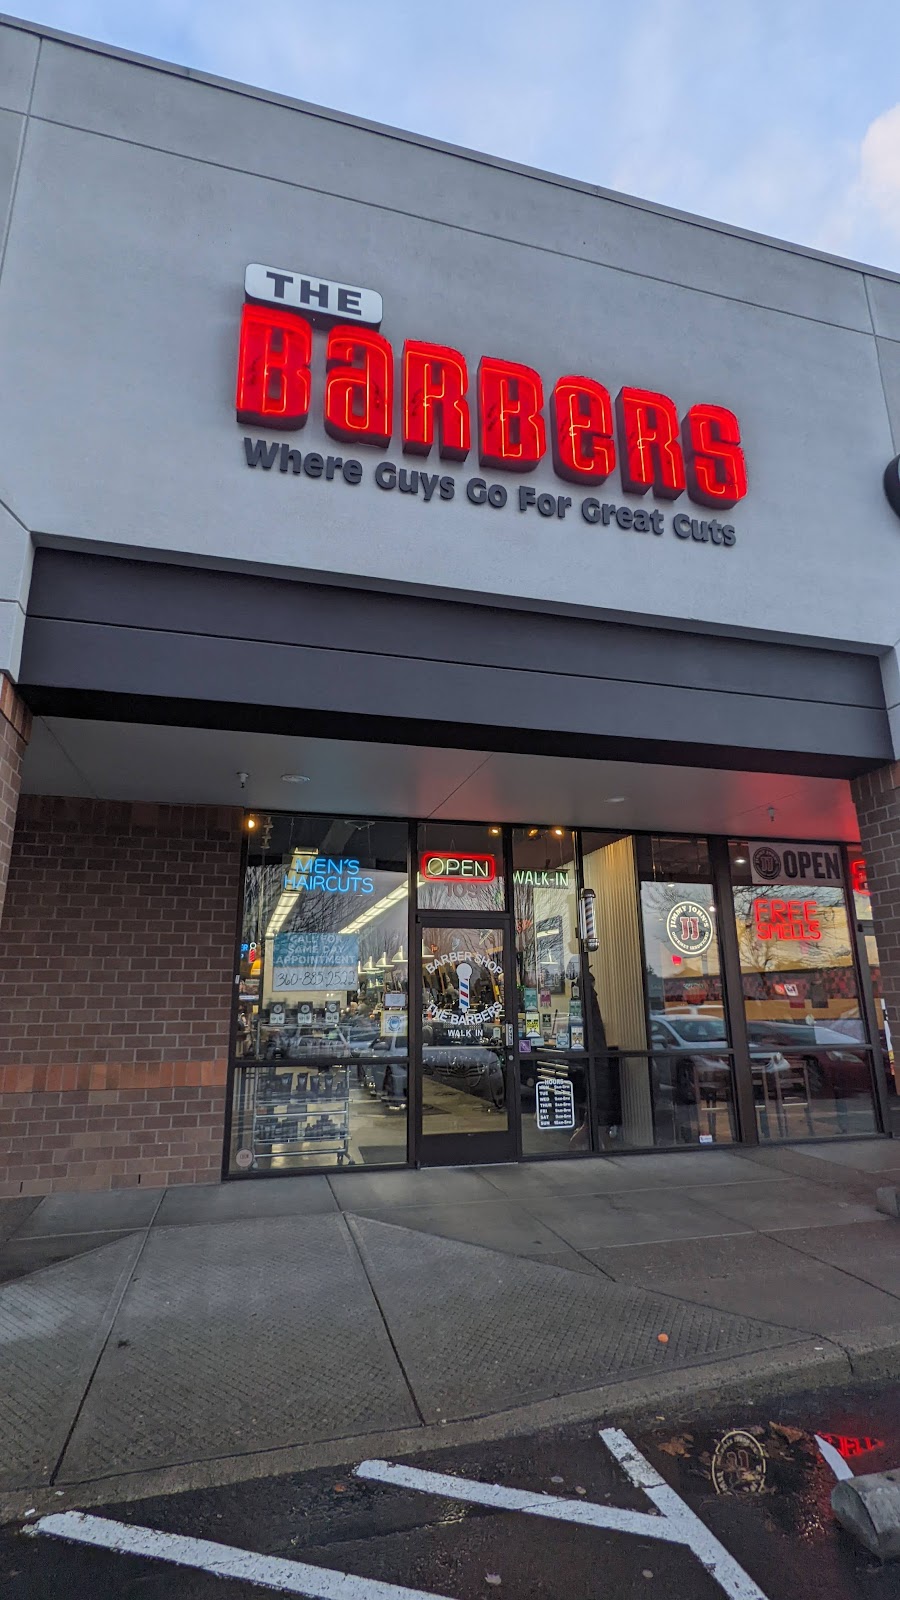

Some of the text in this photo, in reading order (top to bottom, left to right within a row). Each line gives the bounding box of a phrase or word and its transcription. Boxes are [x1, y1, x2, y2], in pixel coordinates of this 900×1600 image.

[266, 270, 363, 317] THE
[243, 436, 737, 546] Where Guys Go For Great Cuts
[296, 858, 360, 875] MEN'S
[428, 857, 489, 877] OPEN
[783, 850, 841, 879] OPEN
[284, 875, 374, 893] HAIRCUTS
[513, 869, 569, 887] WALK-IN
[670, 905, 709, 928] JIMMY JOHN'S
[754, 898, 819, 925] FREE
[757, 922, 822, 941] SMELLS
[288, 945, 346, 954] SAME DAY
[425, 951, 503, 974] BARBER SHOP
[427, 1001, 503, 1026] THE BARBERS
[448, 1029, 484, 1037] WALK IN
